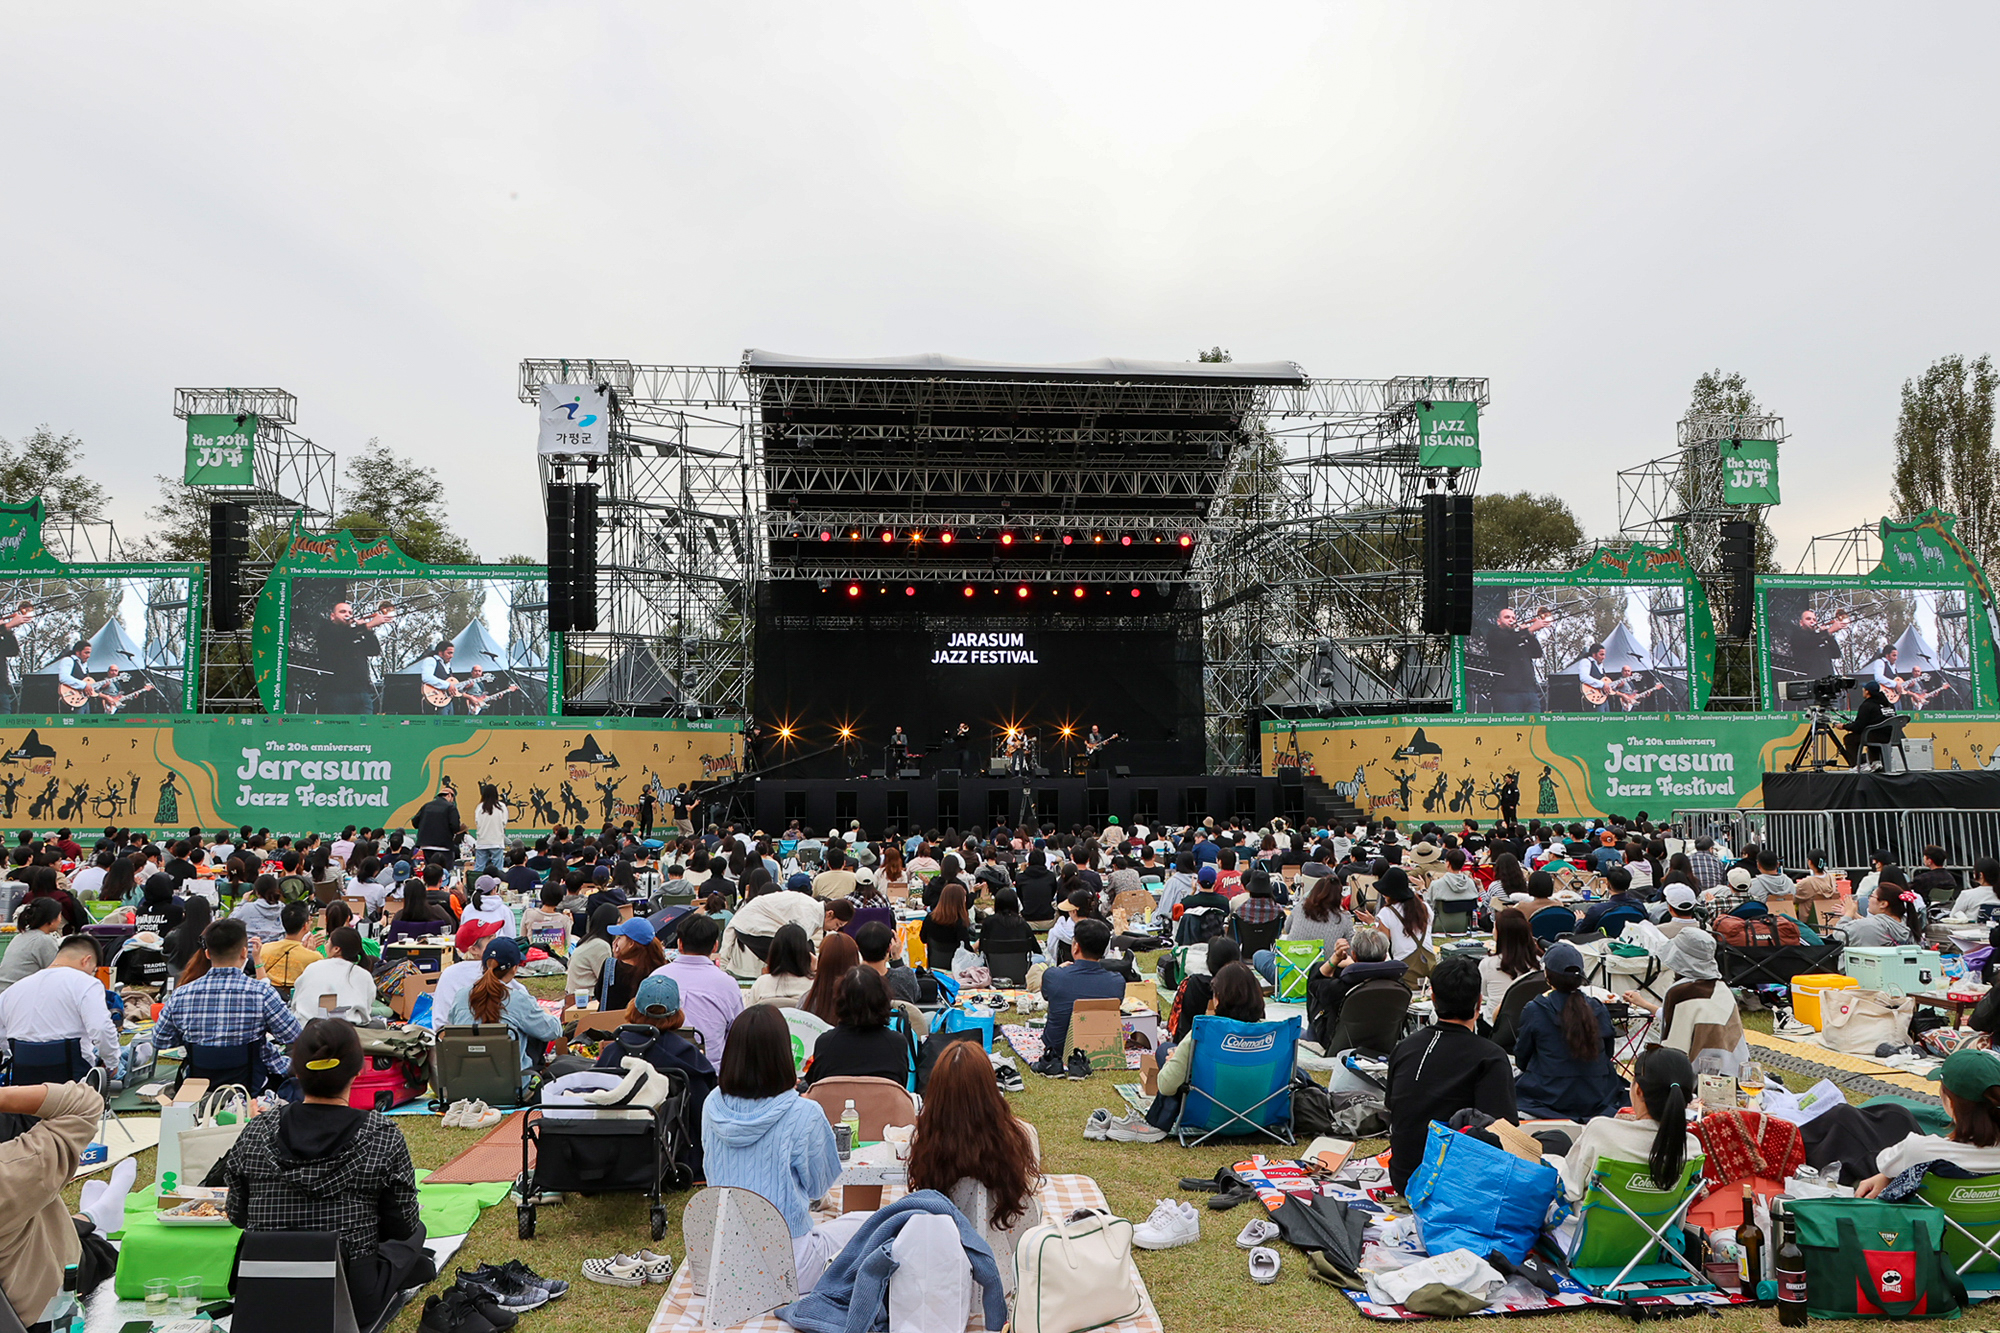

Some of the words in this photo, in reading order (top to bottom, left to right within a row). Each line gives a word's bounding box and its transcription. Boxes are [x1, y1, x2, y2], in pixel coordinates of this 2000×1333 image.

[1431, 420, 1465, 434] JAZZ
[192, 434, 214, 446] the
[216, 434, 248, 446] 20th
[556, 433, 593, 445] 가평군
[1424, 435, 1475, 447] ISLAND
[1726, 456, 1744, 468] the
[1746, 458, 1772, 470] 20th
[947, 632, 1024, 647] JARASUM
[931, 650, 968, 664] JAZZ
[970, 650, 1038, 664] FESTIVAL
[1601, 714, 1624, 722] Jarasum
[1623, 714, 1637, 722] Jazz
[266, 740, 285, 751] The
[288, 742, 308, 751] 20th
[310, 742, 372, 754] anniversary
[1626, 736, 1644, 746] The
[1664, 737, 1716, 747] anniversary
[236, 747, 392, 780] Jarasum
[1604, 742, 1734, 773] Jarasum
[1606, 777, 1652, 797] Jazz
[1656, 774, 1736, 796] Festival
[236, 784, 290, 806] Jazz
[294, 782, 390, 807] Festival
[1228, 1036, 1264, 1048] Coleman
[1956, 1190, 1994, 1200] Coleman
